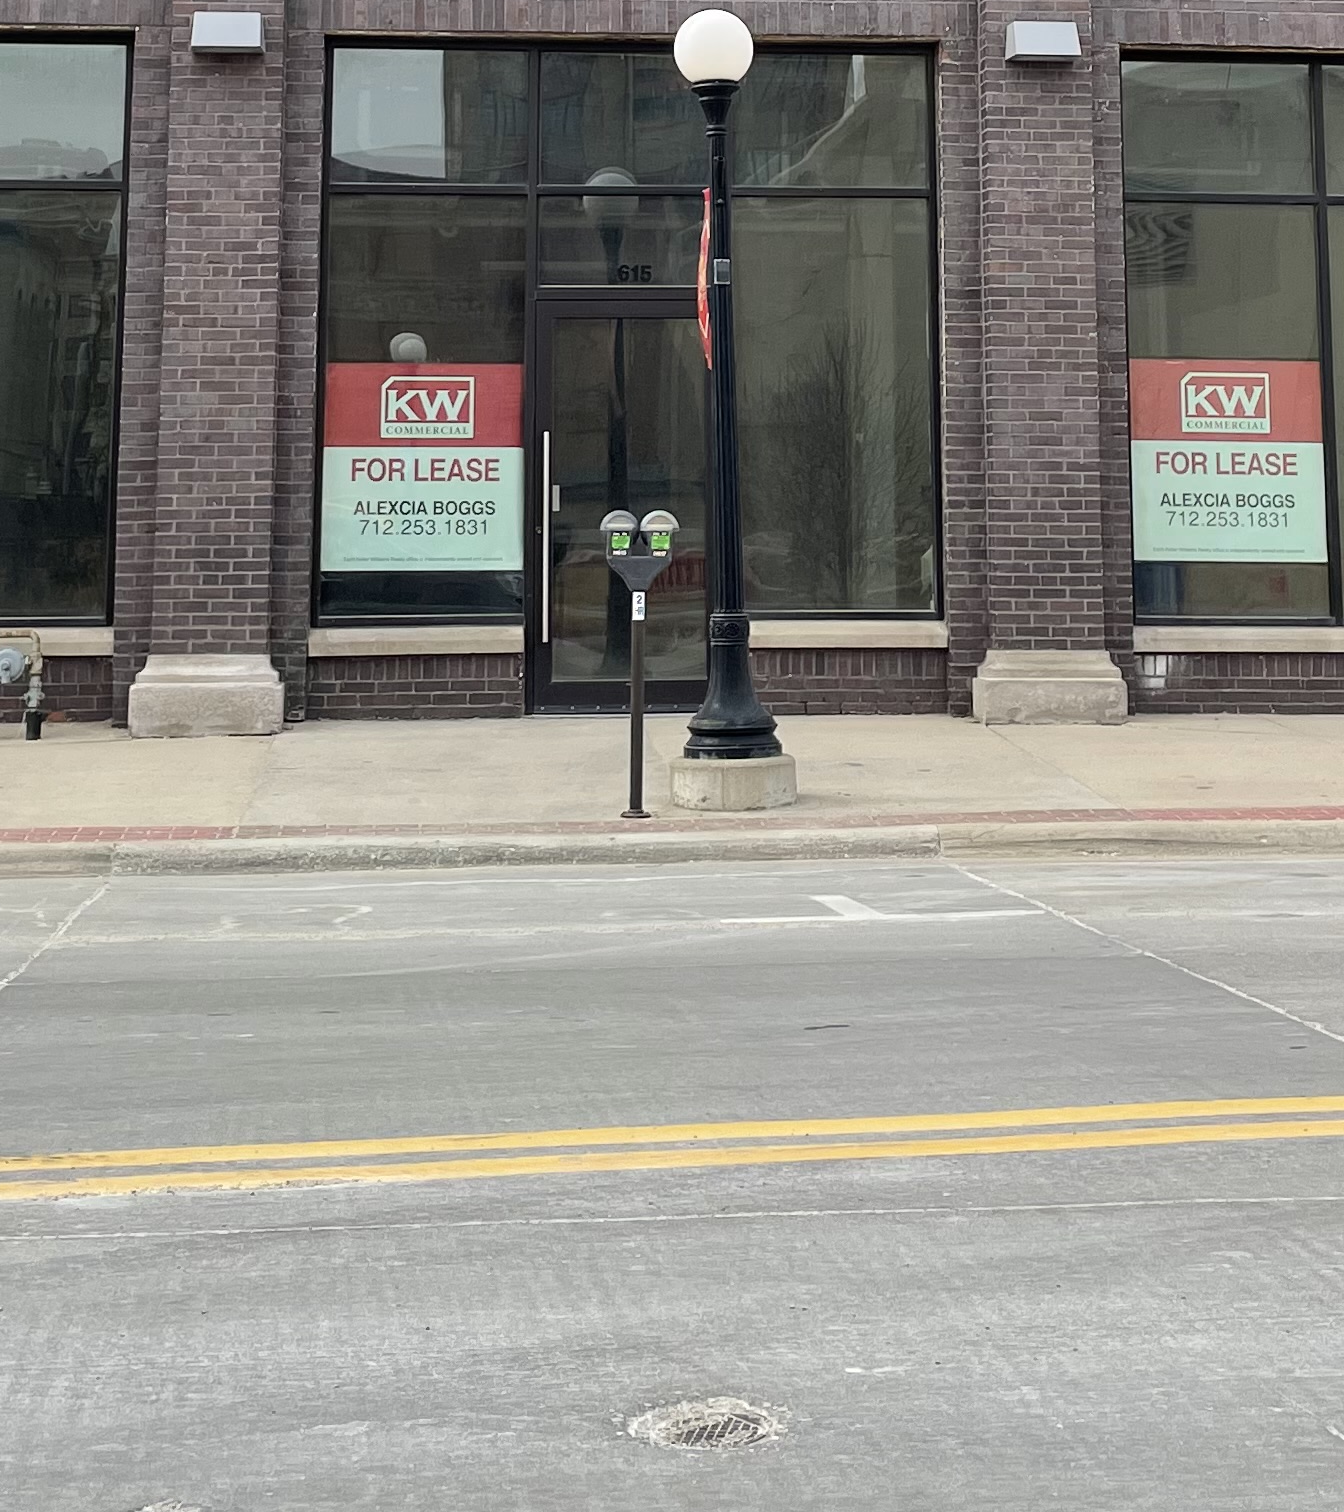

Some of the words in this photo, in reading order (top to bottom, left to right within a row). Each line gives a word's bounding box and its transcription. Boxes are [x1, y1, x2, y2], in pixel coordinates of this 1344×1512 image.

[617, 264, 652, 283] 615
[386, 389, 470, 422] KW
[1186, 384, 1264, 417] KW
[385, 425, 469, 435] COMMERCIAL
[1186, 419, 1267, 430] COMMERCIAL
[351, 457, 406, 482] FOR
[414, 457, 500, 482] LEASE
[1156, 451, 1208, 475] FOR
[1216, 452, 1299, 476] LEASE
[353, 500, 429, 516] ALEXCIA
[433, 500, 496, 516] BOGGS
[1160, 492, 1231, 508] ALEXCIA
[1235, 493, 1296, 509] BOGGS
[358, 519, 488, 536] 712.253.1831
[1165, 510, 1289, 528] 712.253.1831
[636, 594, 643, 605] 2
